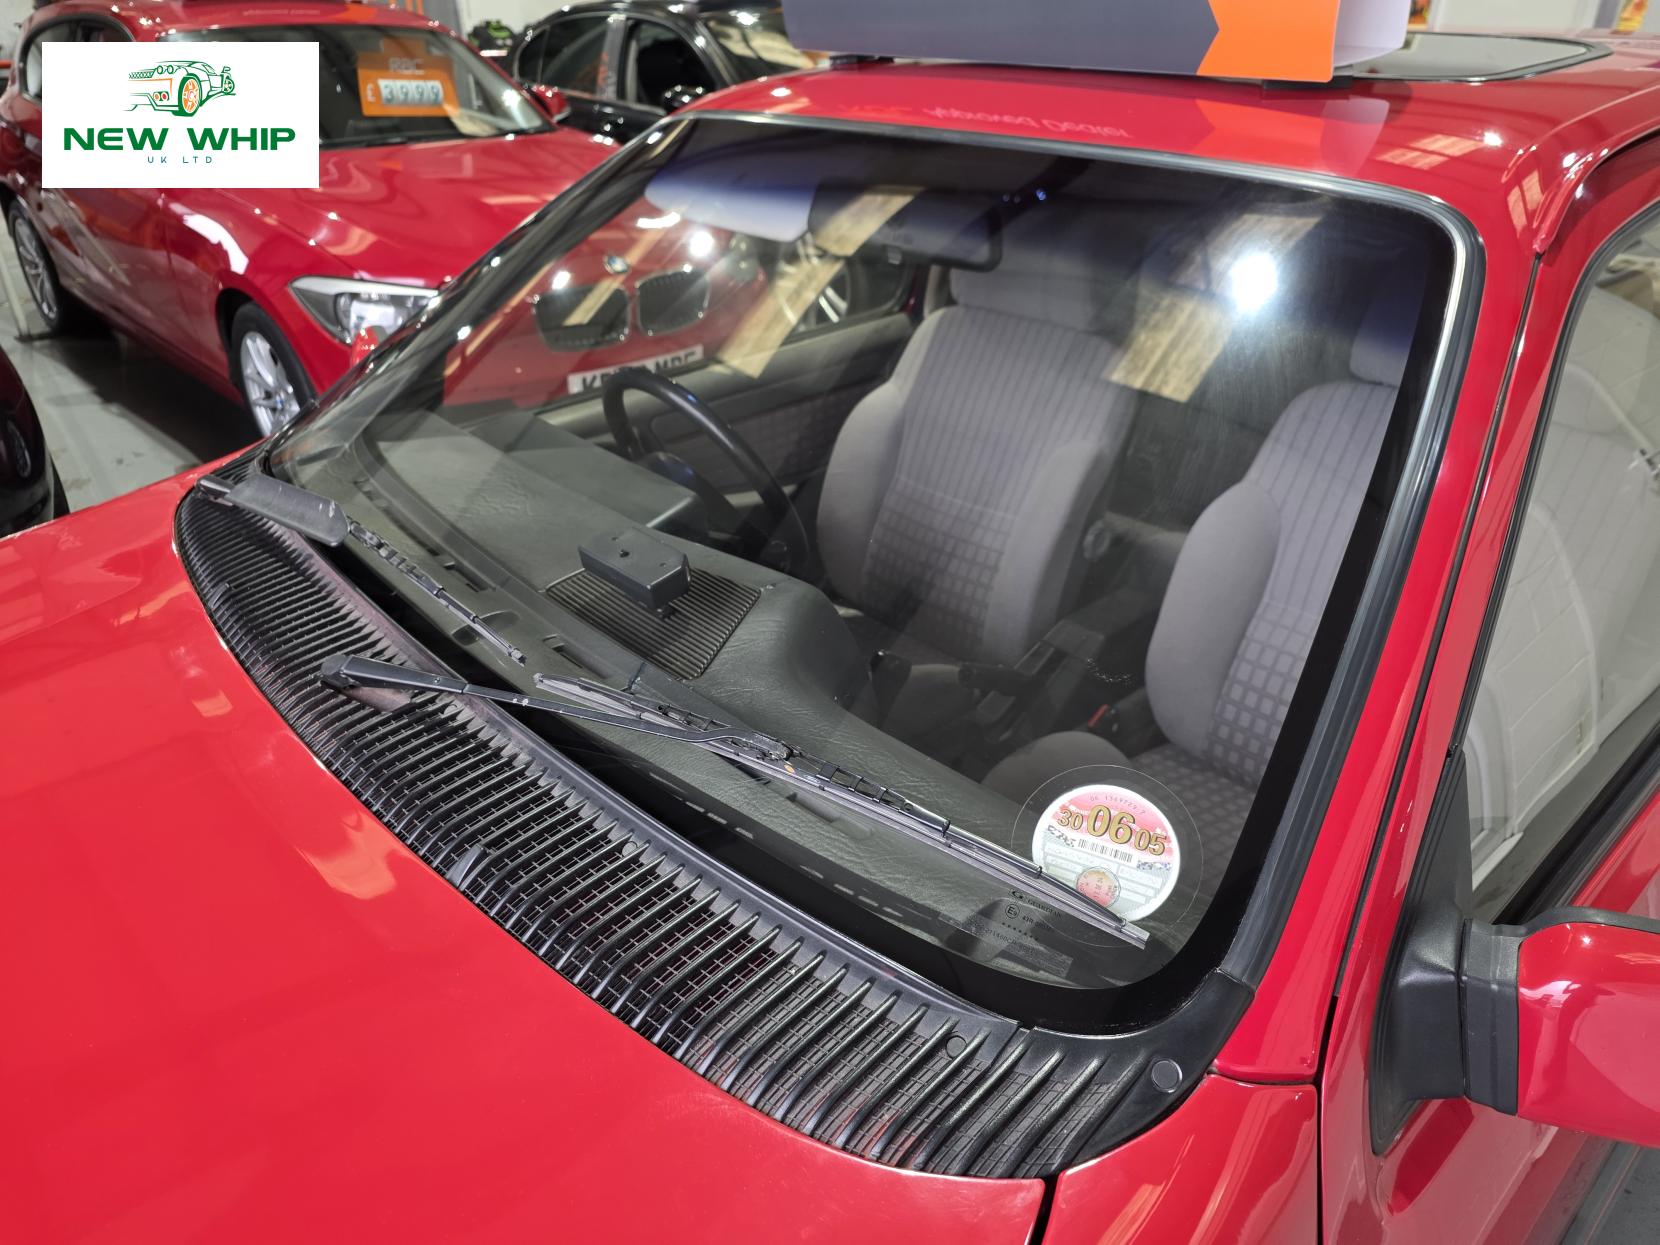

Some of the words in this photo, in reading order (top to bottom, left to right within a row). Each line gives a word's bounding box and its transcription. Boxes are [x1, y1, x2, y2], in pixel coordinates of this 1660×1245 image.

[1057, 808, 1084, 831] 30
[1087, 804, 1136, 845] 06
[1133, 828, 1168, 856] 05
